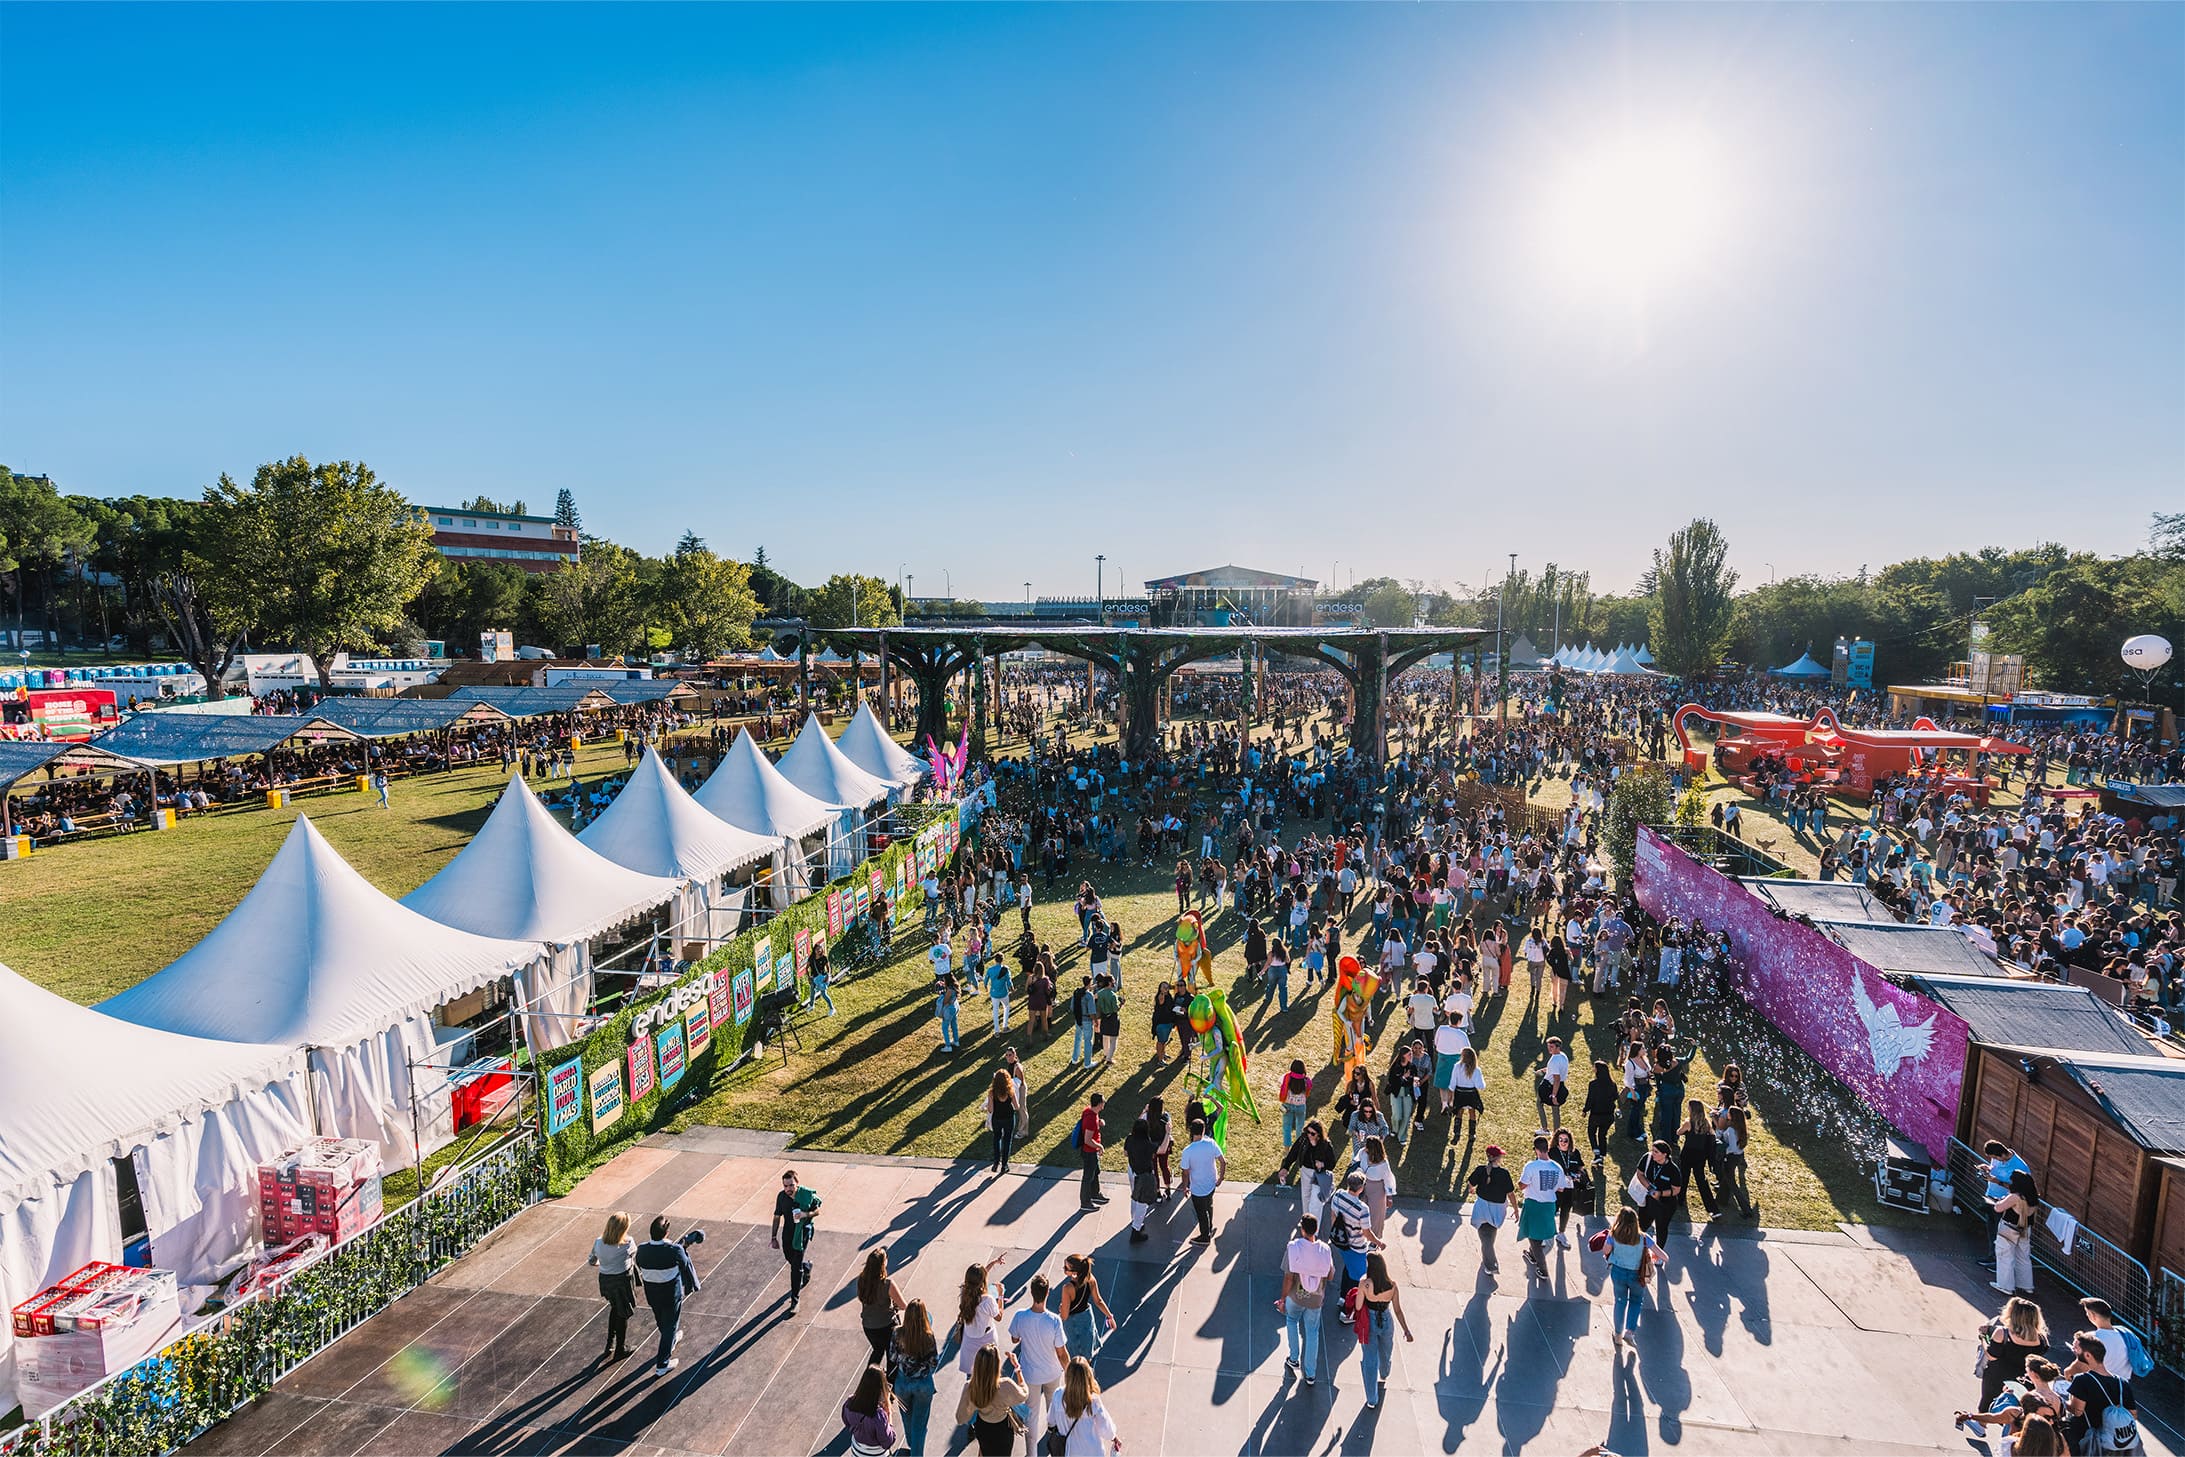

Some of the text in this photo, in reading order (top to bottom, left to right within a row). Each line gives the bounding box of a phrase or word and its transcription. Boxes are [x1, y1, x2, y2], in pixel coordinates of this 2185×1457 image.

[1104, 602, 1148, 612] endesa
[1315, 602, 1362, 612] endesa
[484, 638, 495, 648] WC
[2109, 782, 2132, 792] CASHLESS
[631, 971, 714, 1038] endesa
[554, 1075, 578, 1098] DARLO
[554, 1112, 562, 1128] Y
